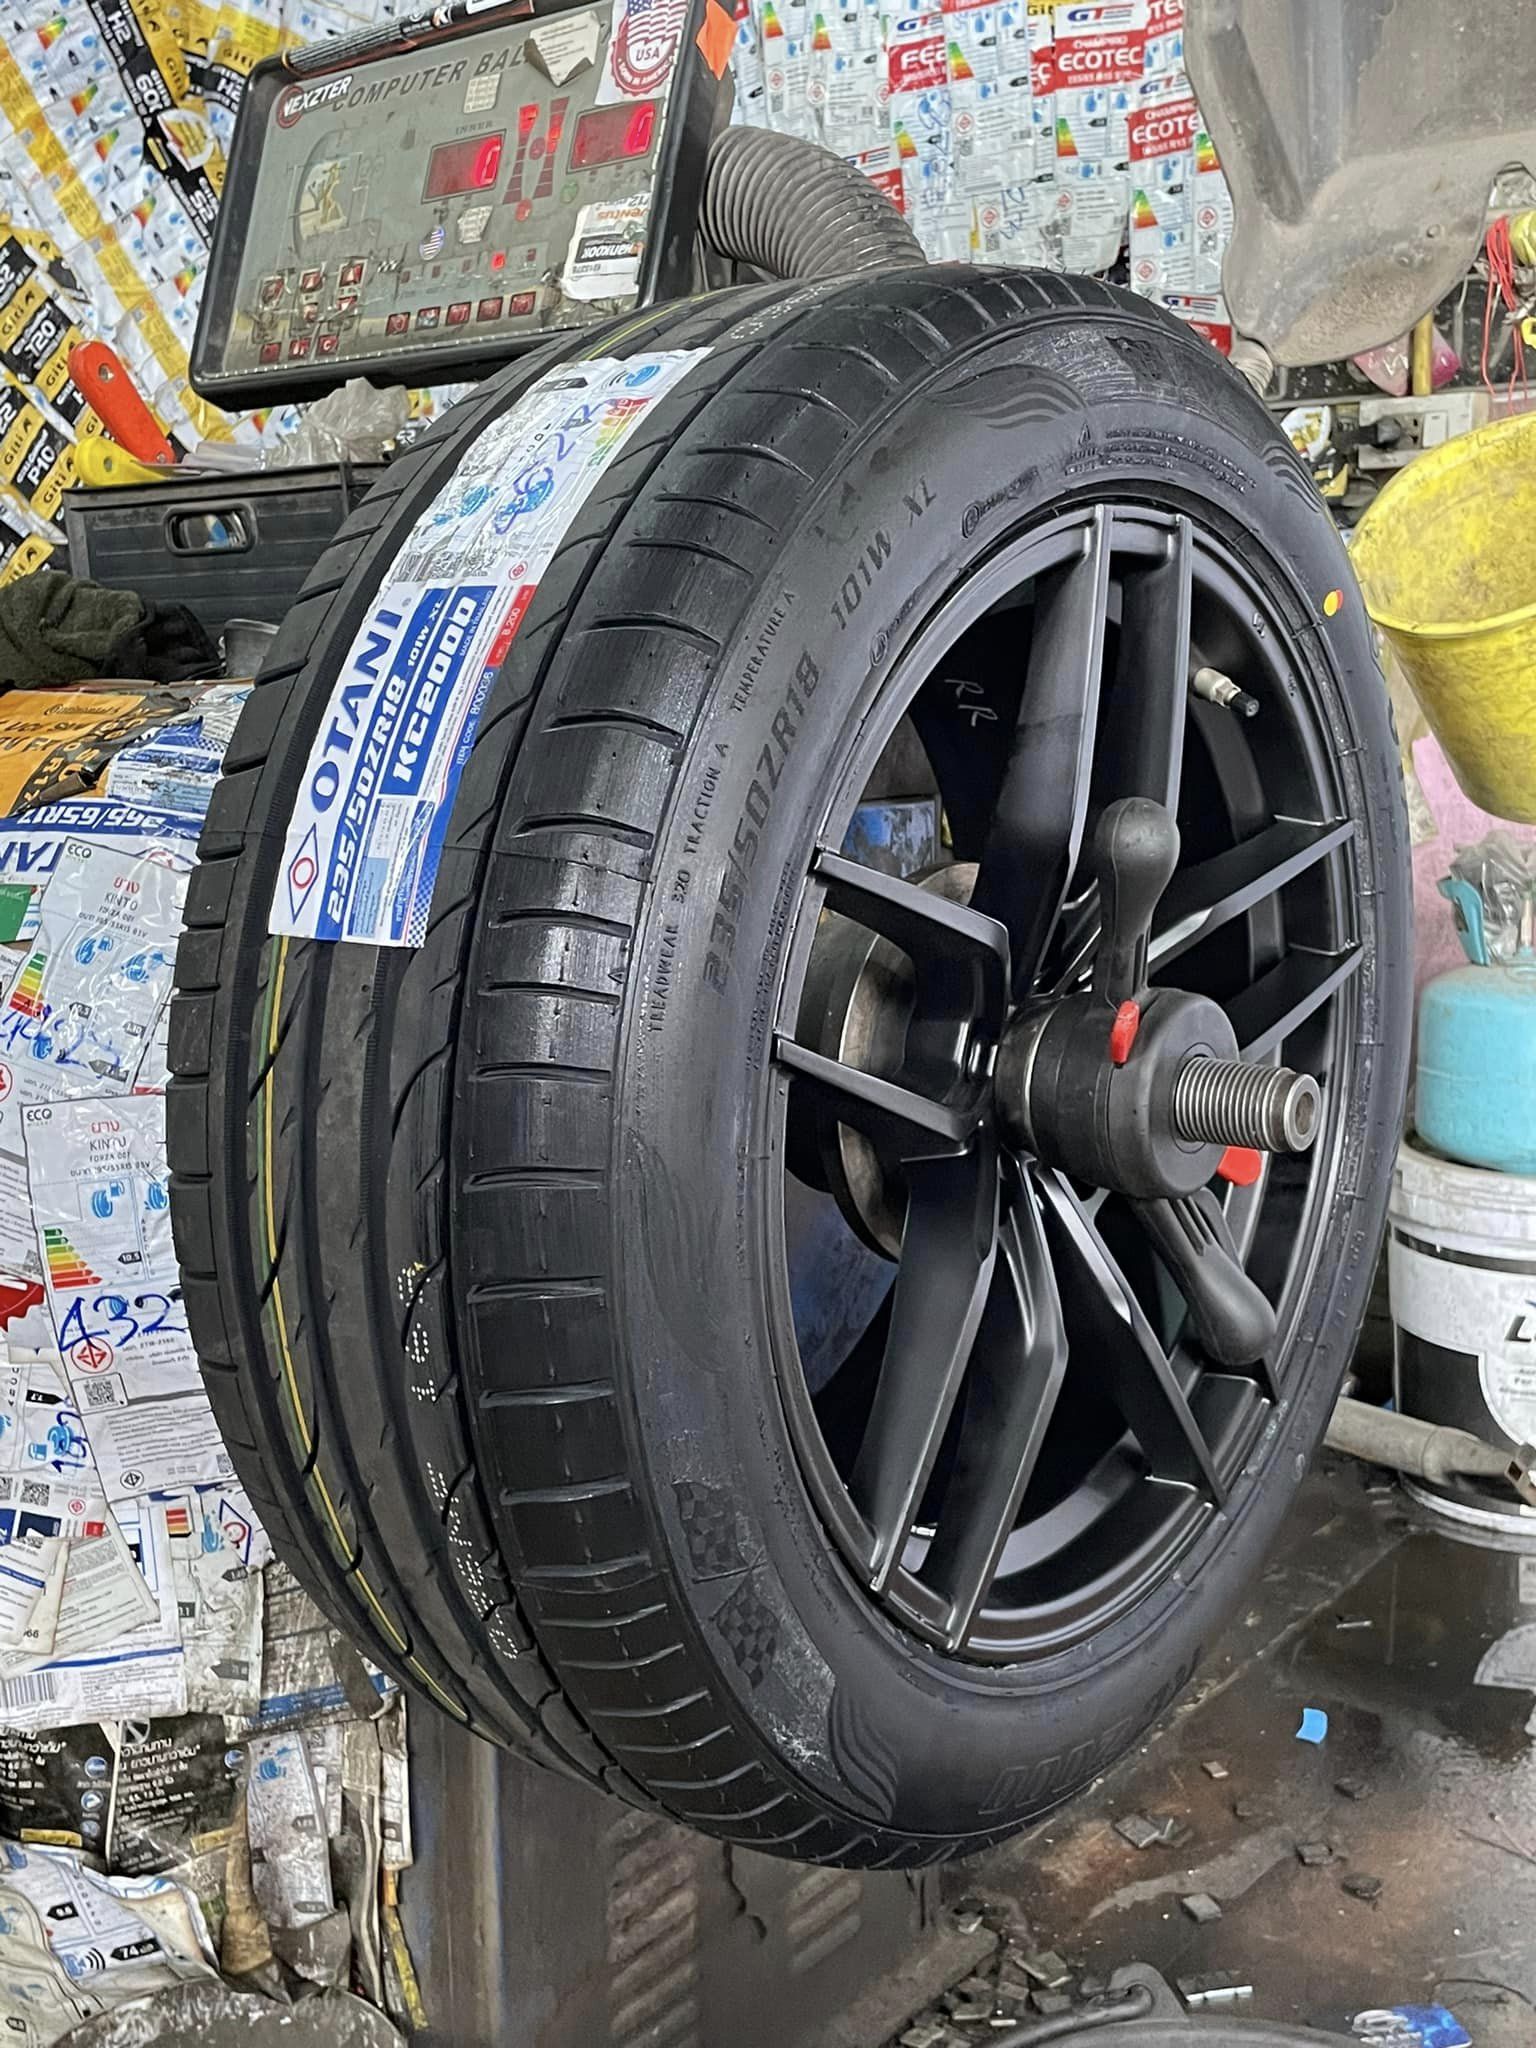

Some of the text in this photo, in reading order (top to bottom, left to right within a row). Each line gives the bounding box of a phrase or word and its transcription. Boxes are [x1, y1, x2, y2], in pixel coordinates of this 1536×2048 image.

[635, 47, 660, 62] USA
[1057, 45, 1143, 72] ECOTEC
[23, 319, 58, 358] T20
[27, 446, 56, 486] P10
[43, 472, 67, 505] Giti
[831, 530, 893, 631] 101W
[732, 590, 796, 712] TEMPERATURE A
[392, 596, 477, 784] KC2000
[310, 608, 403, 813] OTANI
[327, 674, 406, 925] 235/50ZR18
[406, 625, 430, 667] 101W
[683, 741, 729, 855] TRACTION A
[703, 650, 820, 998] 235/50ZR18
[67, 843, 92, 859] ECO
[671, 869, 691, 906] 320
[646, 923, 680, 1034] TREADWEAR
[26, 1109, 52, 1122] ECO
[119, 1944, 138, 1959] 74
